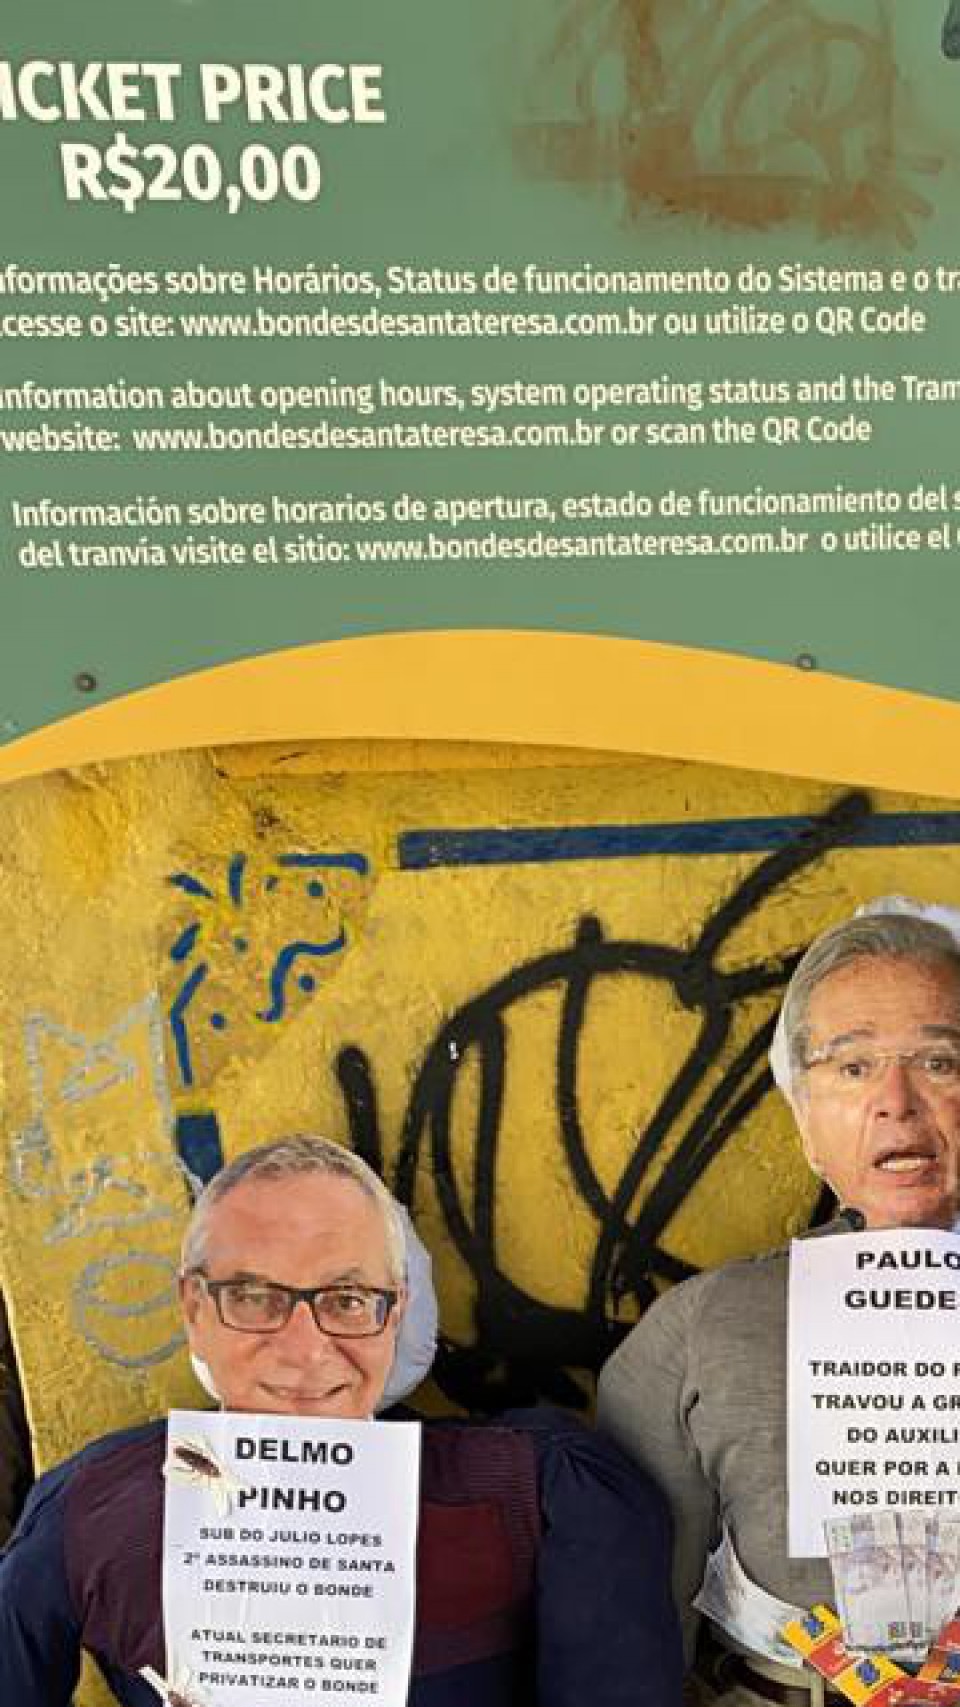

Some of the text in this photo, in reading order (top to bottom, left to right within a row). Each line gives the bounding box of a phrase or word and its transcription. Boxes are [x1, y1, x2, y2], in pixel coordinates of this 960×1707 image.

[200, 64, 384, 123] PRICE
[61, 133, 320, 213] R$20,00
[165, 264, 245, 293] sobre
[254, 264, 381, 299] Horários,
[387, 267, 477, 293] Status
[483, 266, 517, 293] de
[525, 264, 730, 293] funcionamento
[738, 264, 771, 293] do
[779, 264, 883, 291] Sistema
[891, 272, 906, 291] e
[914, 270, 928, 291] o
[0, 304, 925, 336] cesse o site: www.bondesdesantateresa.com.br ou utilize o QR Code
[171, 381, 253, 408] about
[261, 379, 374, 414] opening
[381, 379, 464, 409] hours,
[472, 381, 565, 411] system
[574, 376, 704, 411] operating
[709, 379, 789, 403] status
[797, 374, 845, 402] and
[853, 376, 896, 400] the
[0, 414, 872, 451] website: www.bondesdesantateresa.com.br or scan the QR Code
[13, 496, 181, 526] Información
[189, 499, 264, 523] sobre
[272, 494, 387, 523] horarios
[394, 494, 427, 520] de
[434, 496, 555, 526] apertura,
[563, 491, 652, 517] estado
[659, 491, 691, 515] de
[699, 486, 901, 515] funcionamiento
[909, 485, 947, 510] del
[19, 541, 64, 568] del
[69, 538, 166, 566] tranvía
[172, 536, 245, 563] visite
[253, 537, 277, 563] el
[285, 534, 349, 562] sitio:
[357, 526, 808, 560] www.bondesdesantateresa.com.br
[821, 533, 837, 552] o
[845, 523, 920, 550] utilice
[928, 523, 950, 549] el
[809, 1360, 908, 1377] TRAIDOR
[914, 1362, 945, 1377] DO
[811, 1394, 905, 1412] TRAVOU
[911, 1394, 926, 1412] A
[847, 1426, 878, 1444] DO
[234, 1437, 353, 1466] DELMO
[815, 1460, 878, 1476] QUER
[884, 1460, 929, 1476] POR
[935, 1460, 950, 1476] A
[833, 1490, 879, 1505] NOS
[199, 1527, 382, 1548] SUB DO JULIO LOPES
[205, 1554, 305, 1569] ASSASSINO
[308, 1557, 331, 1570] DE
[337, 1559, 396, 1572] SANTA
[204, 1578, 373, 1598] DESTRUIU O BONDE
[191, 1629, 385, 1649] ATUAL SECRETARIO DE
[202, 1650, 377, 1671] TRANSPORTES QUER
[199, 1671, 377, 1694] PRIVATIZAR O BONDE
